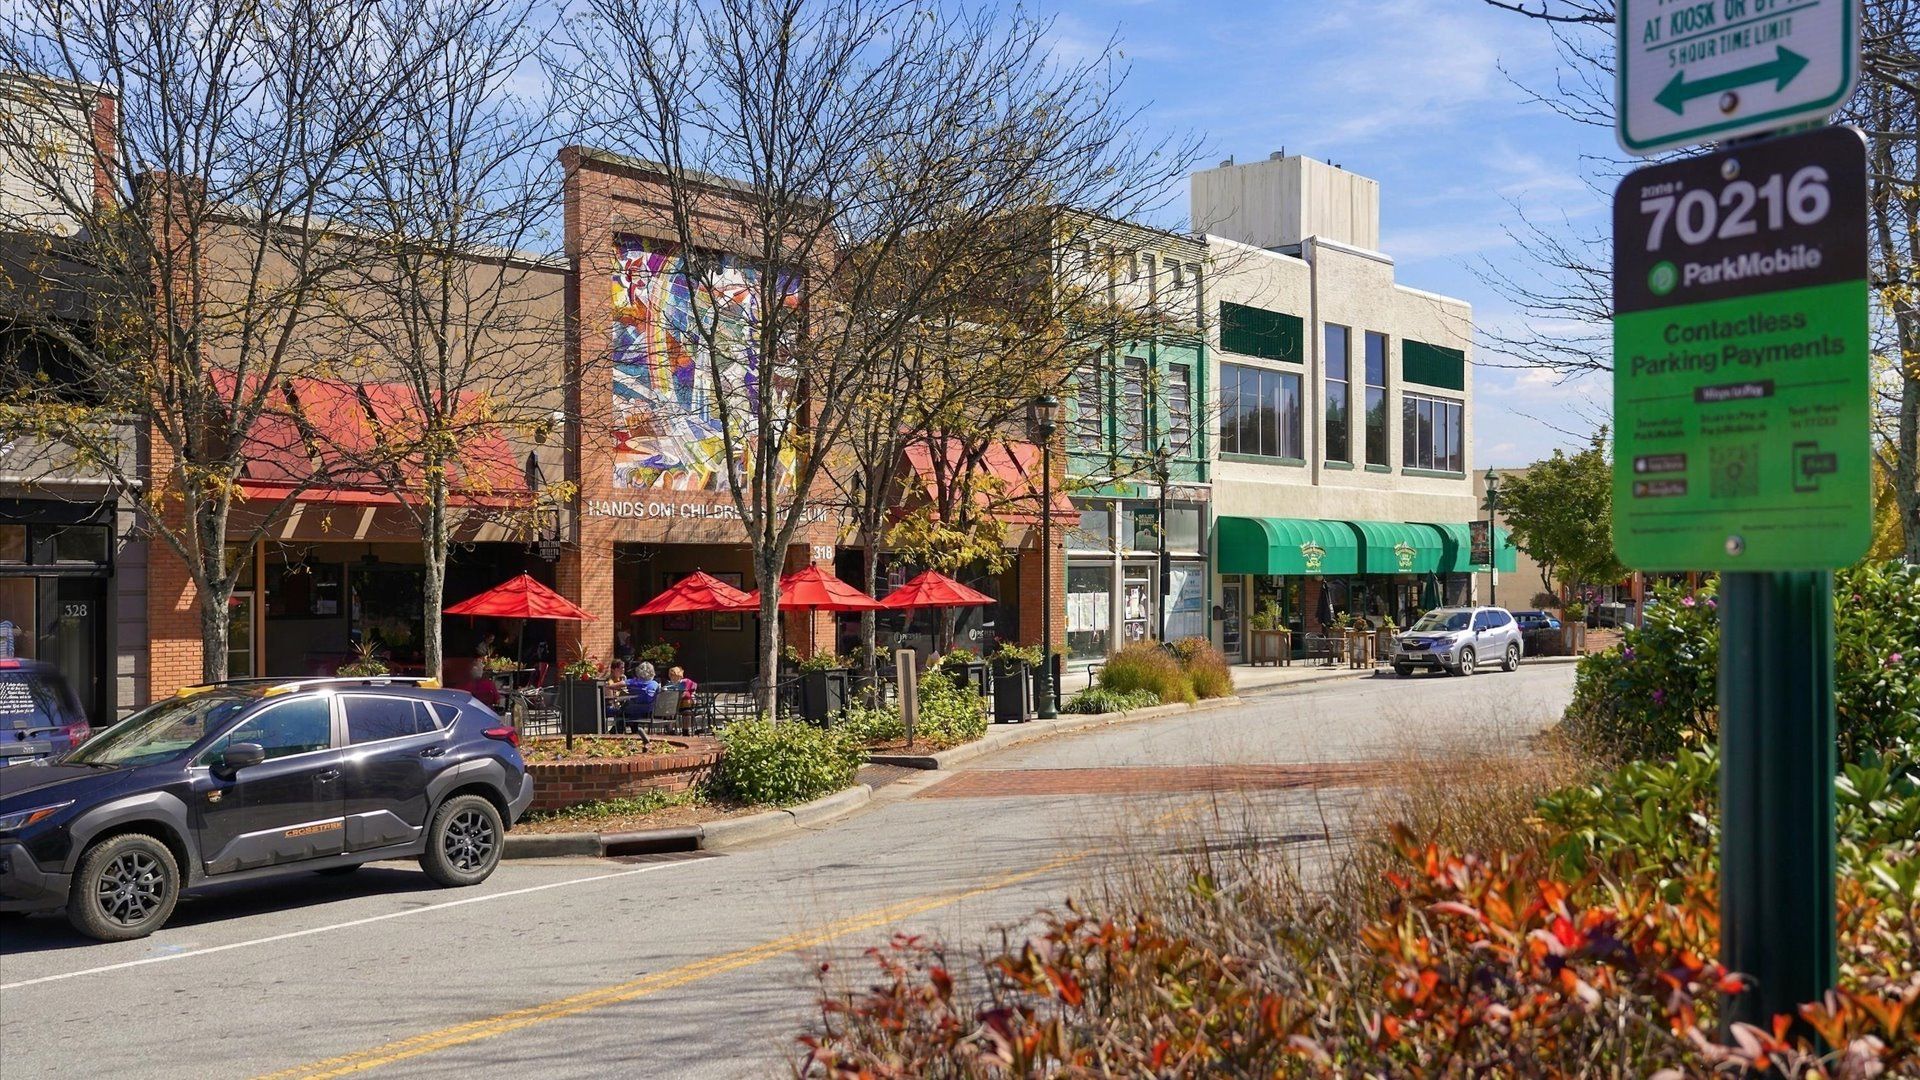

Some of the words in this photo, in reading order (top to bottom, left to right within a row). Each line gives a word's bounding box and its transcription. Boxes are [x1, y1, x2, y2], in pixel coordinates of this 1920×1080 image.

[1643, 16, 1662, 44] AT
[1670, 1, 1716, 37] KIOSK
[1668, 49, 1677, 68] 5
[1679, 38, 1716, 65] HOUR
[1720, 27, 1750, 55] TIME
[1754, 17, 1793, 45] LIMIT
[1640, 165, 1831, 252] 70216
[1683, 244, 1823, 287] ParkMobile
[1663, 311, 1807, 345] Contactless
[1631, 349, 1718, 378] Parking
[1722, 335, 1846, 368] Payments
[588, 500, 644, 518] HANDS
[648, 502, 675, 518] ON!
[814, 545, 833, 560] 318
[64, 604, 88, 617] 328
